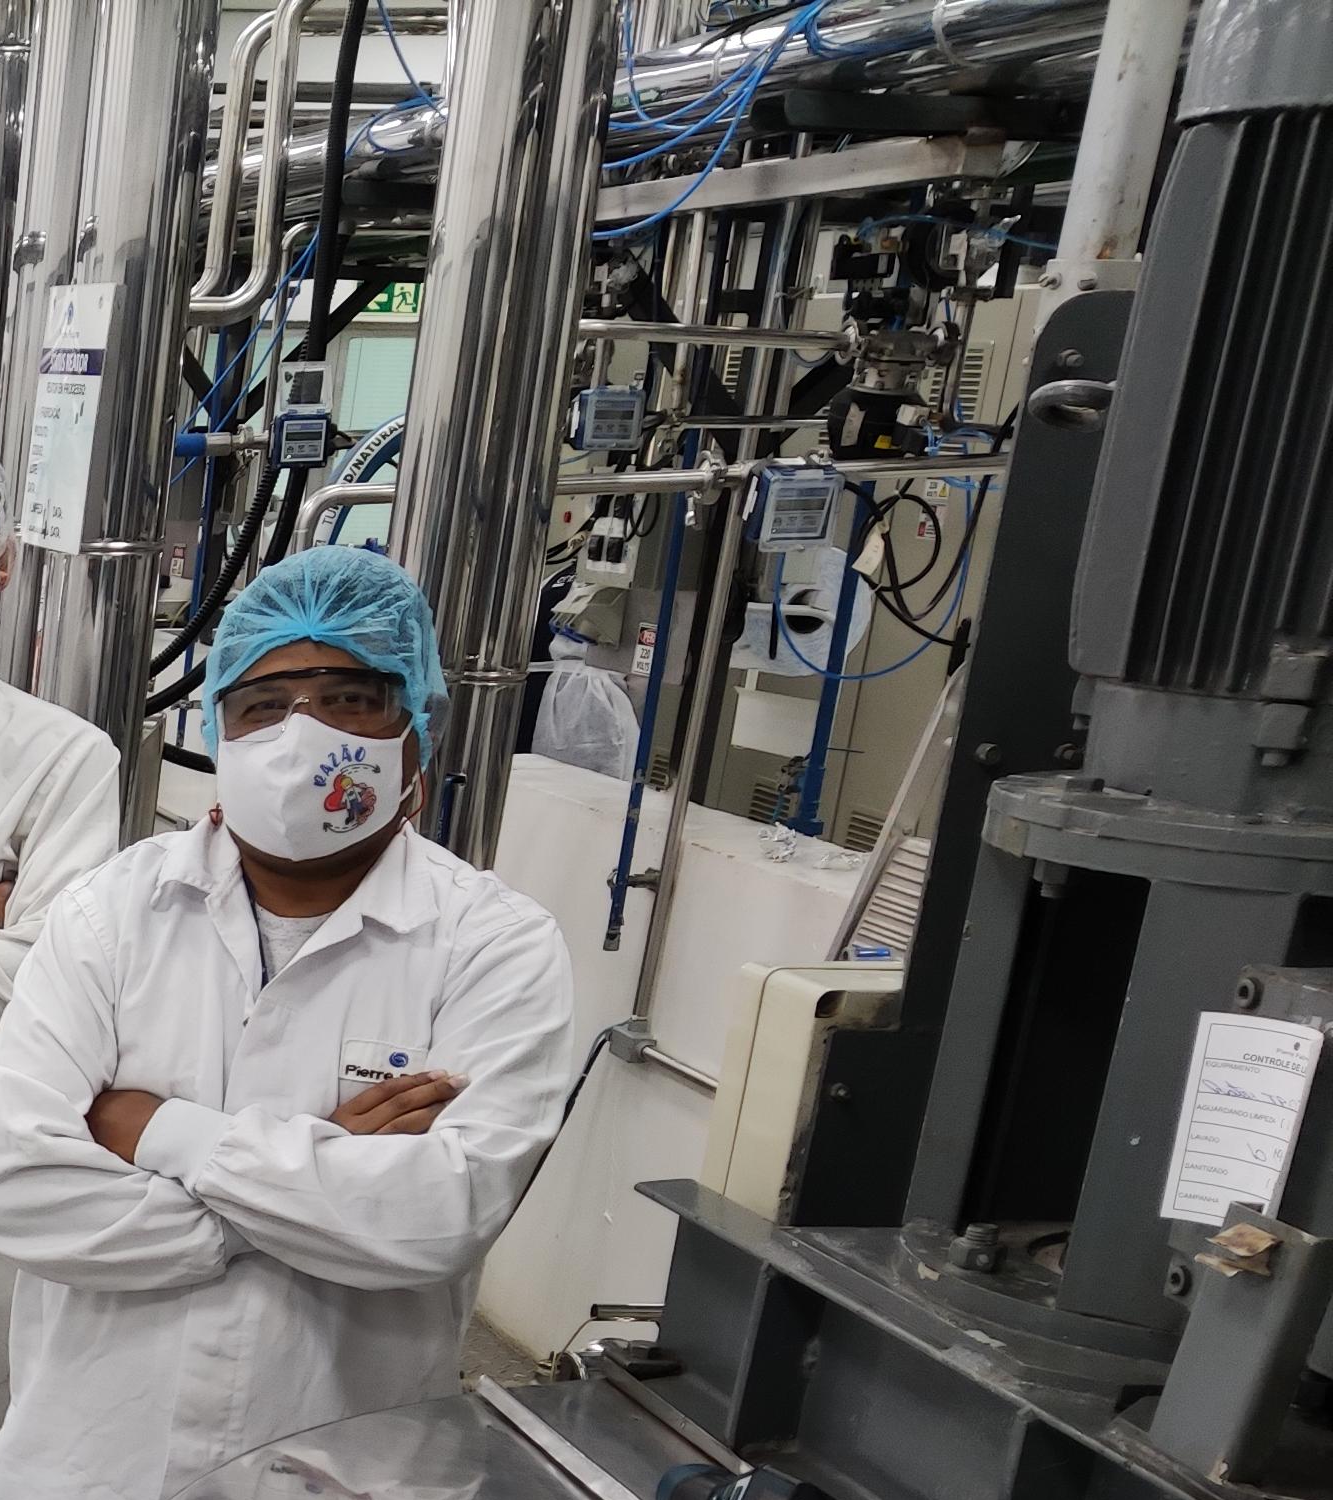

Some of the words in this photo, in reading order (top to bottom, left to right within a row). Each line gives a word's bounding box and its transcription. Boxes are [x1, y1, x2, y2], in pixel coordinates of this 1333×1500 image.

[313, 743, 367, 789] RAZÃO
[1205, 1060, 1261, 1075] EQUIPAMENTO
[1242, 1053, 1291, 1069] CONTROLE
[1291, 1062, 1301, 1072] DE
[344, 1064, 394, 1081] Pierre
